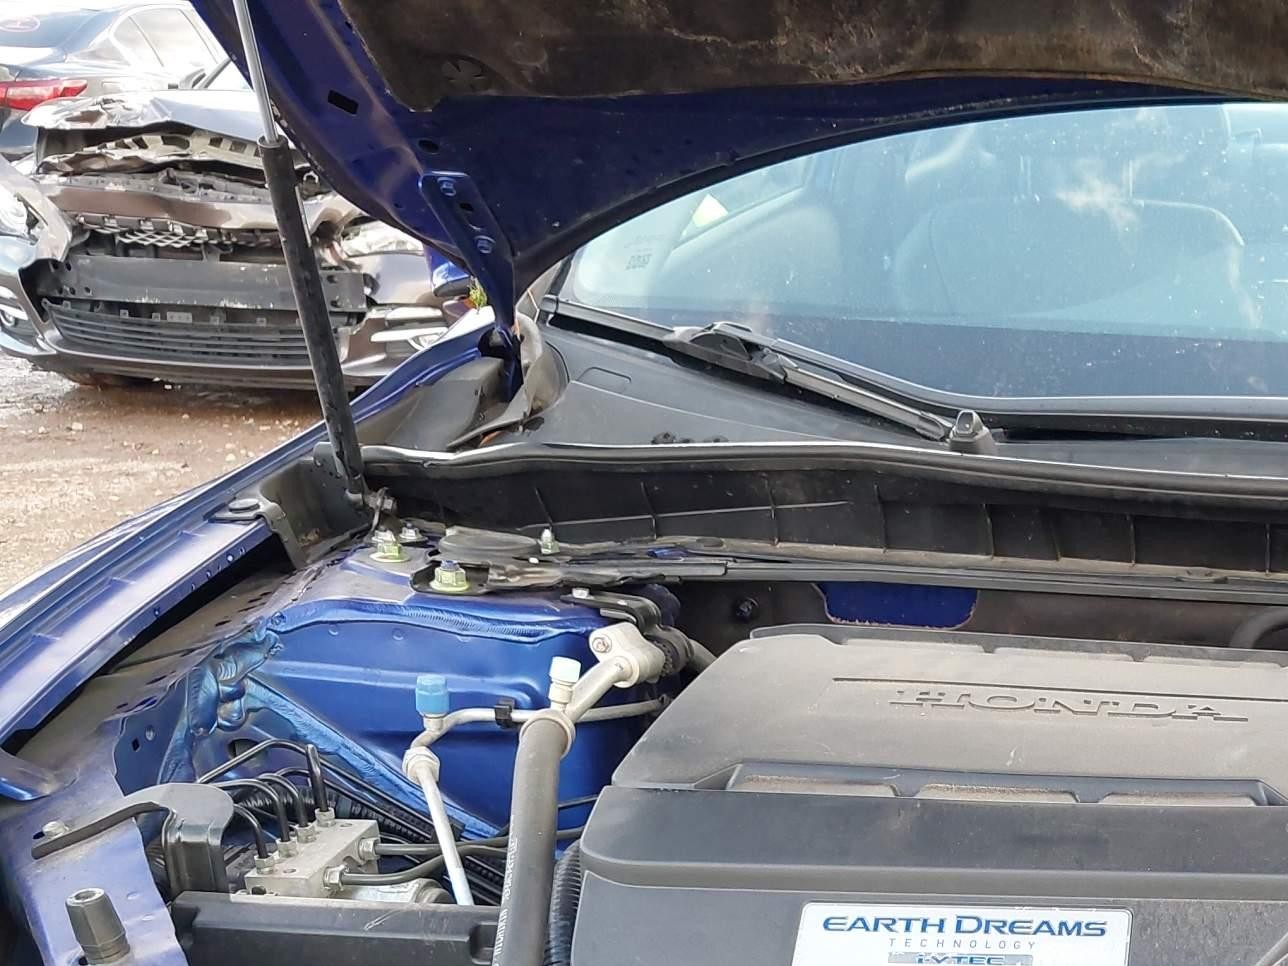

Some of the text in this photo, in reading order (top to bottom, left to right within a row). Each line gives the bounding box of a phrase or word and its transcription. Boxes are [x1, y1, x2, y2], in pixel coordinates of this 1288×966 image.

[889, 689, 1248, 722] HONDA
[822, 914, 1108, 937] EARTH DREAMS
[888, 937, 1037, 950] TECHNOLOGY
